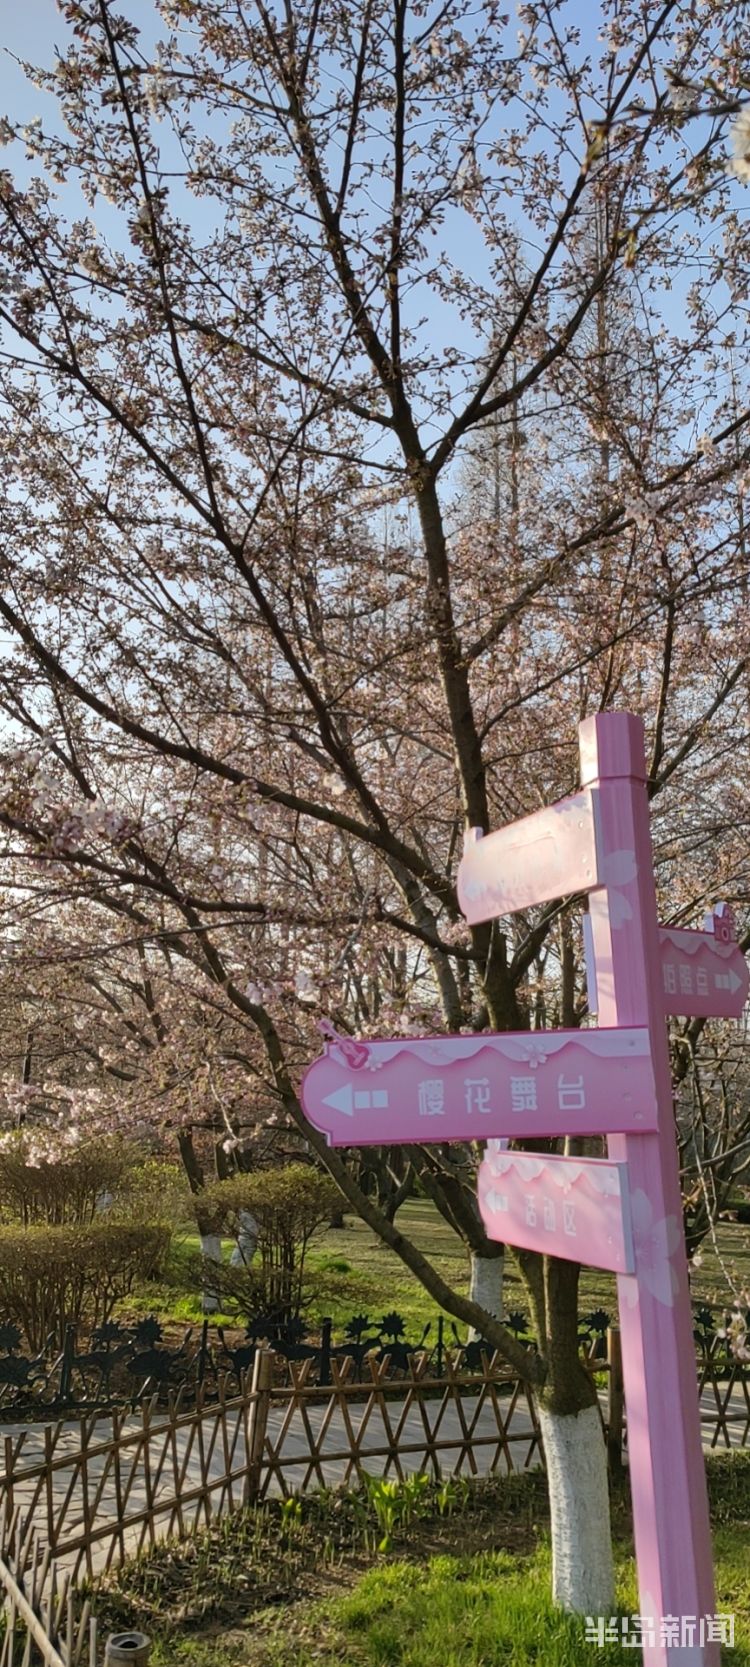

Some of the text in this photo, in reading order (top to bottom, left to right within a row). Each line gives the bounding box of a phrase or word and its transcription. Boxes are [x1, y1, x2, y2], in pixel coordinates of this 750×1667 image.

[418, 1074, 585, 1116] 樱花舞台
[524, 1194, 577, 1237] 活动区
